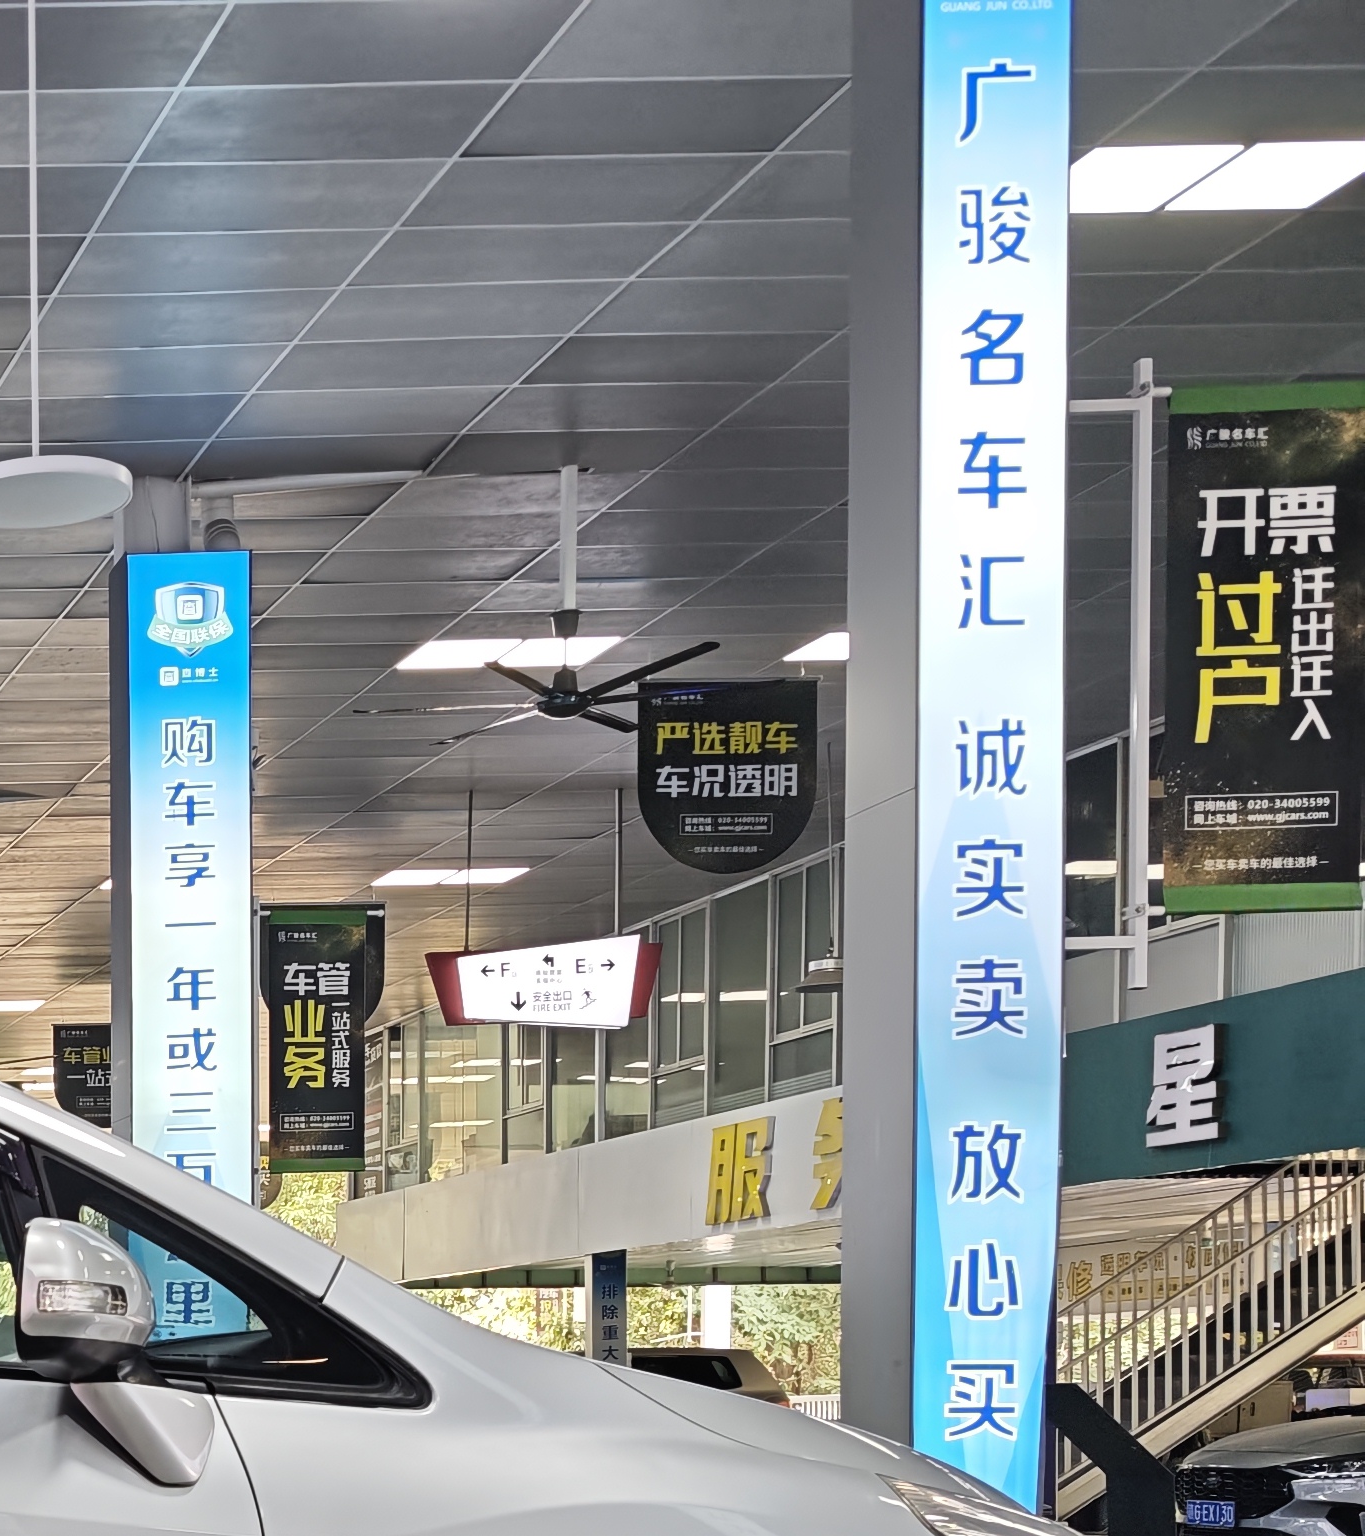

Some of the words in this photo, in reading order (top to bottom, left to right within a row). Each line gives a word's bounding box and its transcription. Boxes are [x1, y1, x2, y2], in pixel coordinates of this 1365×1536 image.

[957, 62, 1032, 630] 广骏名车汇
[1197, 486, 1336, 556] 开票
[152, 620, 229, 645] 全国联保
[1194, 571, 1282, 744] 过户
[1289, 567, 1336, 741] 迁出迁入
[656, 721, 799, 755] 严选靓车
[655, 763, 798, 798] 车况透明
[955, 719, 1029, 1038] 诚实卖
[283, 962, 351, 996] 车管
[533, 991, 572, 1002] 安全出口
[533, 1004, 550, 1012] FIRE
[553, 1003, 571, 1011] EXIT
[161, 717, 218, 1324] 购车享一年或三万里
[283, 999, 326, 1089] 业务
[331, 1001, 351, 1088] 一站式服务
[1146, 1024, 1219, 1148] 星
[945, 1122, 1021, 1438] 放心买
[1057, 1260, 1093, 1301] 修
[601, 1284, 619, 1361] 排除重大
